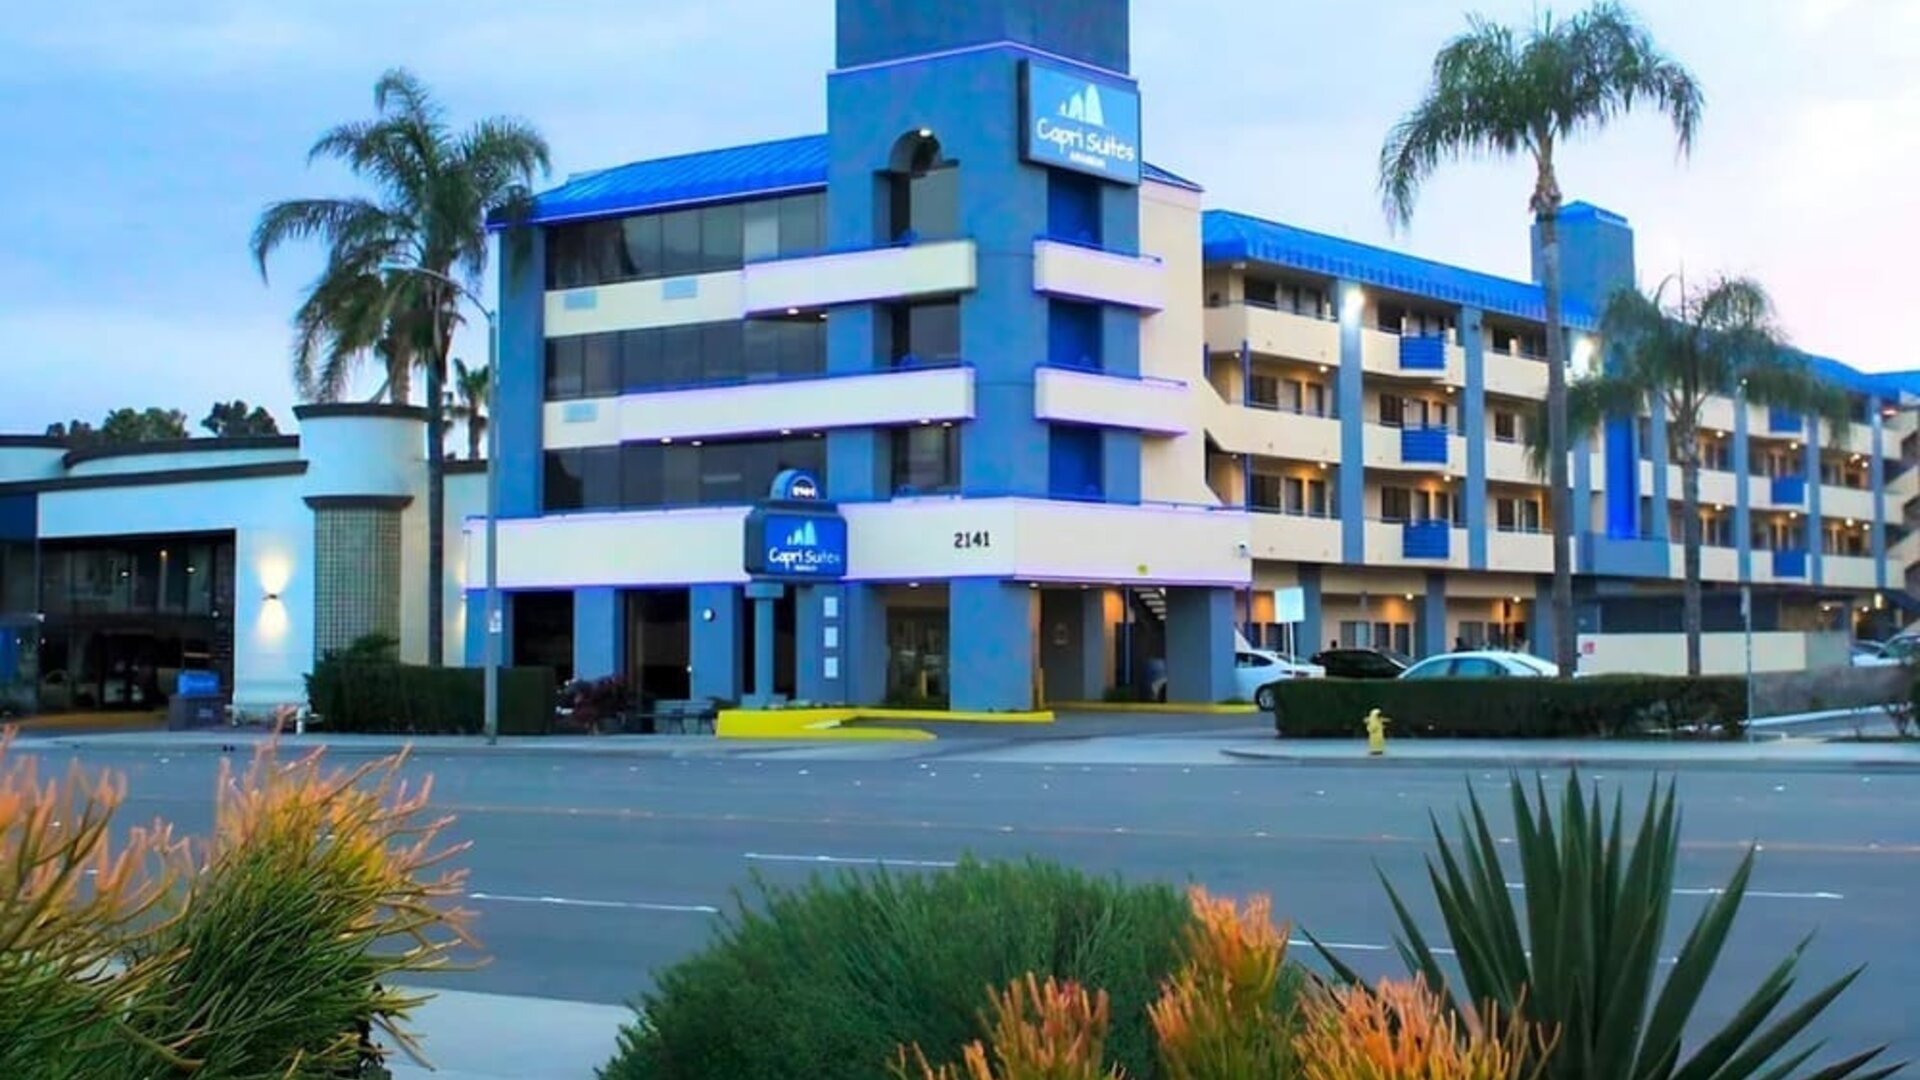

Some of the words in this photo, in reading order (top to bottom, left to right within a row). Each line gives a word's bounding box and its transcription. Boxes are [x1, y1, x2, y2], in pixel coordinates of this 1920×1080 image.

[1036, 117, 1083, 154] Capri
[1086, 132, 1135, 162] Suites
[953, 531, 990, 548] 2141
[768, 546, 803, 571] Capri
